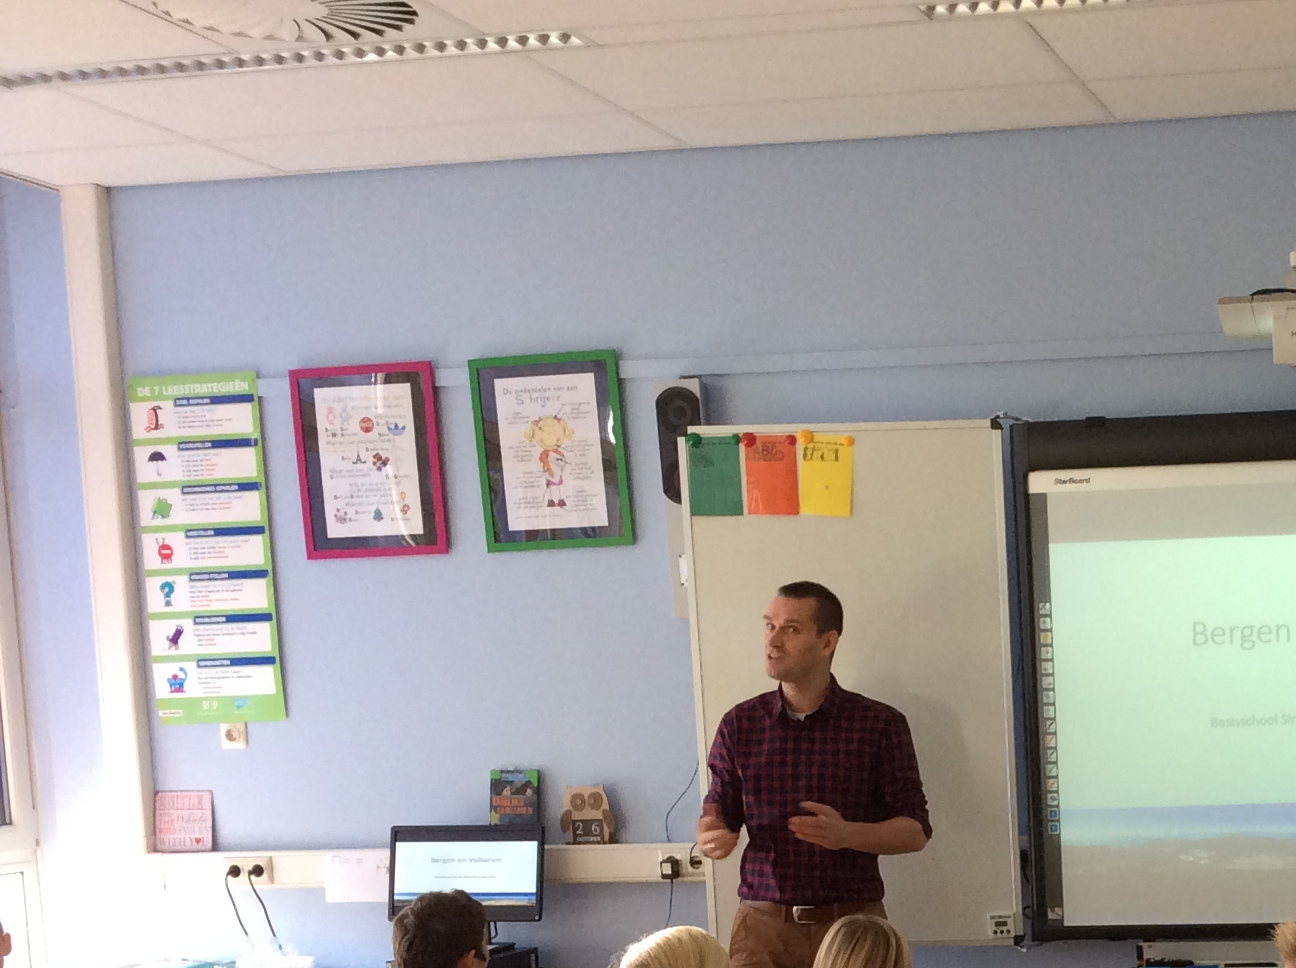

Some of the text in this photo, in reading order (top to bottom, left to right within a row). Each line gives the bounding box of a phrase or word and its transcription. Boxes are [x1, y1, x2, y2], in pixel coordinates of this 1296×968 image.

[137, 380, 249, 396] DE 7 LEESSTRATEGIEËN
[1054, 477, 1090, 485] StarBoard
[1191, 620, 1291, 651] Bergen
[1211, 714, 1278, 728] Basisschool
[159, 837, 186, 847] WITH
